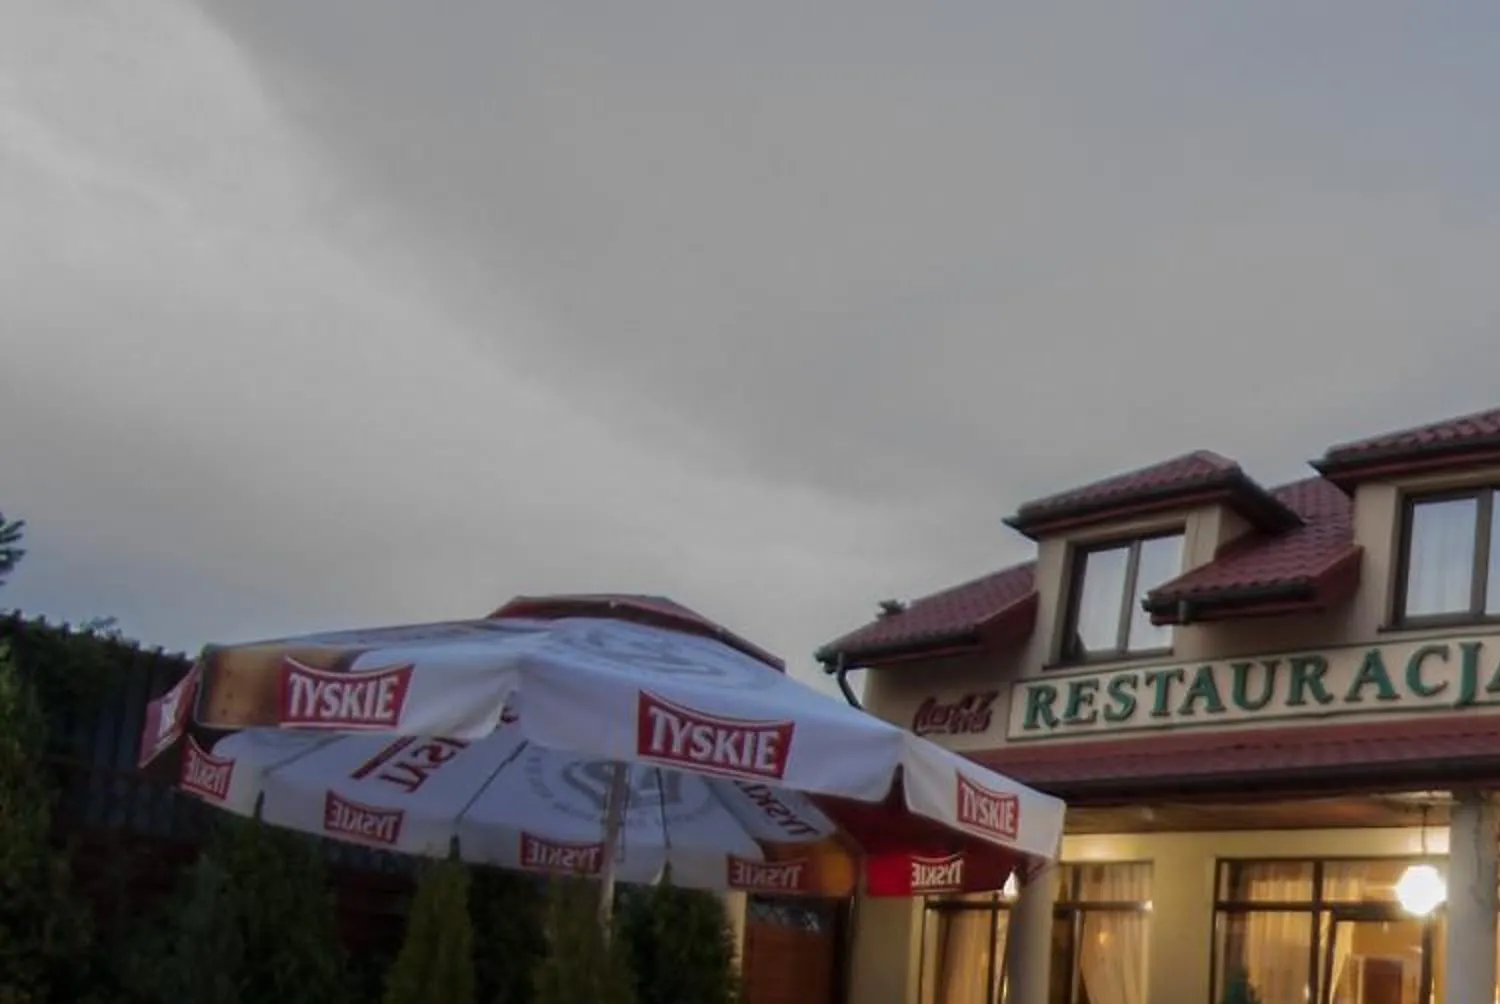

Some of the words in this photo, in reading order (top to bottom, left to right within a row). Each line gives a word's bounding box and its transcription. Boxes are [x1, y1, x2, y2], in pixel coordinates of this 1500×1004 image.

[286, 672, 398, 721] TYSKIE
[648, 706, 780, 773] TYSKIE
[960, 783, 1015, 834] TYSKIE
